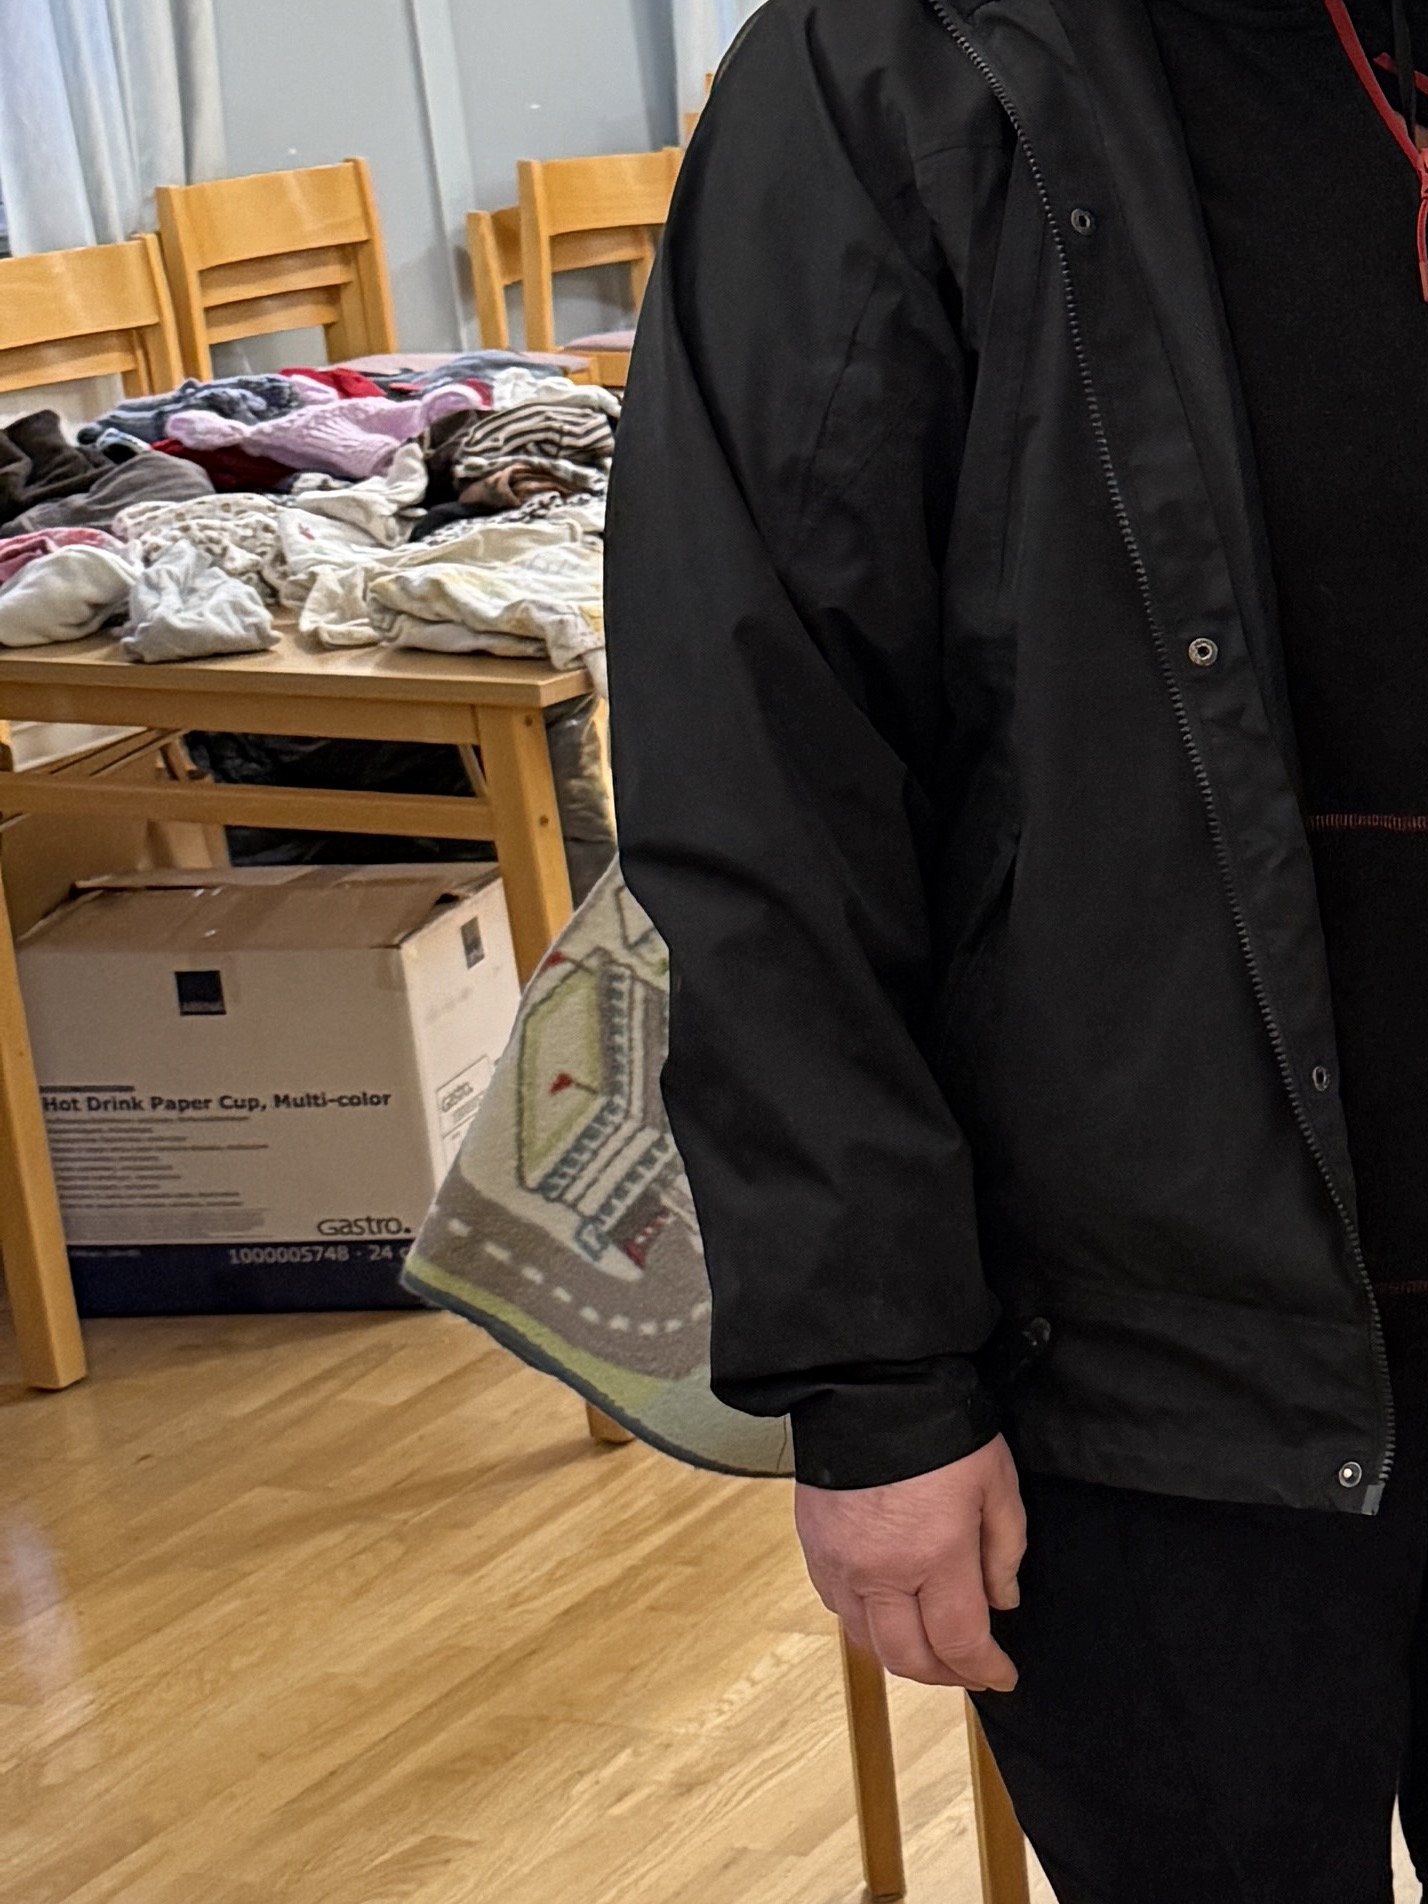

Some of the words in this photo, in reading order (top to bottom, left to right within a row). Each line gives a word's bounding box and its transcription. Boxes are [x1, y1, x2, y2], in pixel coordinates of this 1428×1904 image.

[43, 1097, 80, 1114] Hot
[87, 1096, 144, 1112] Drink
[152, 1095, 213, 1113] Paper
[220, 1094, 267, 1112] Cup,
[274, 1091, 392, 1109] Multi-color
